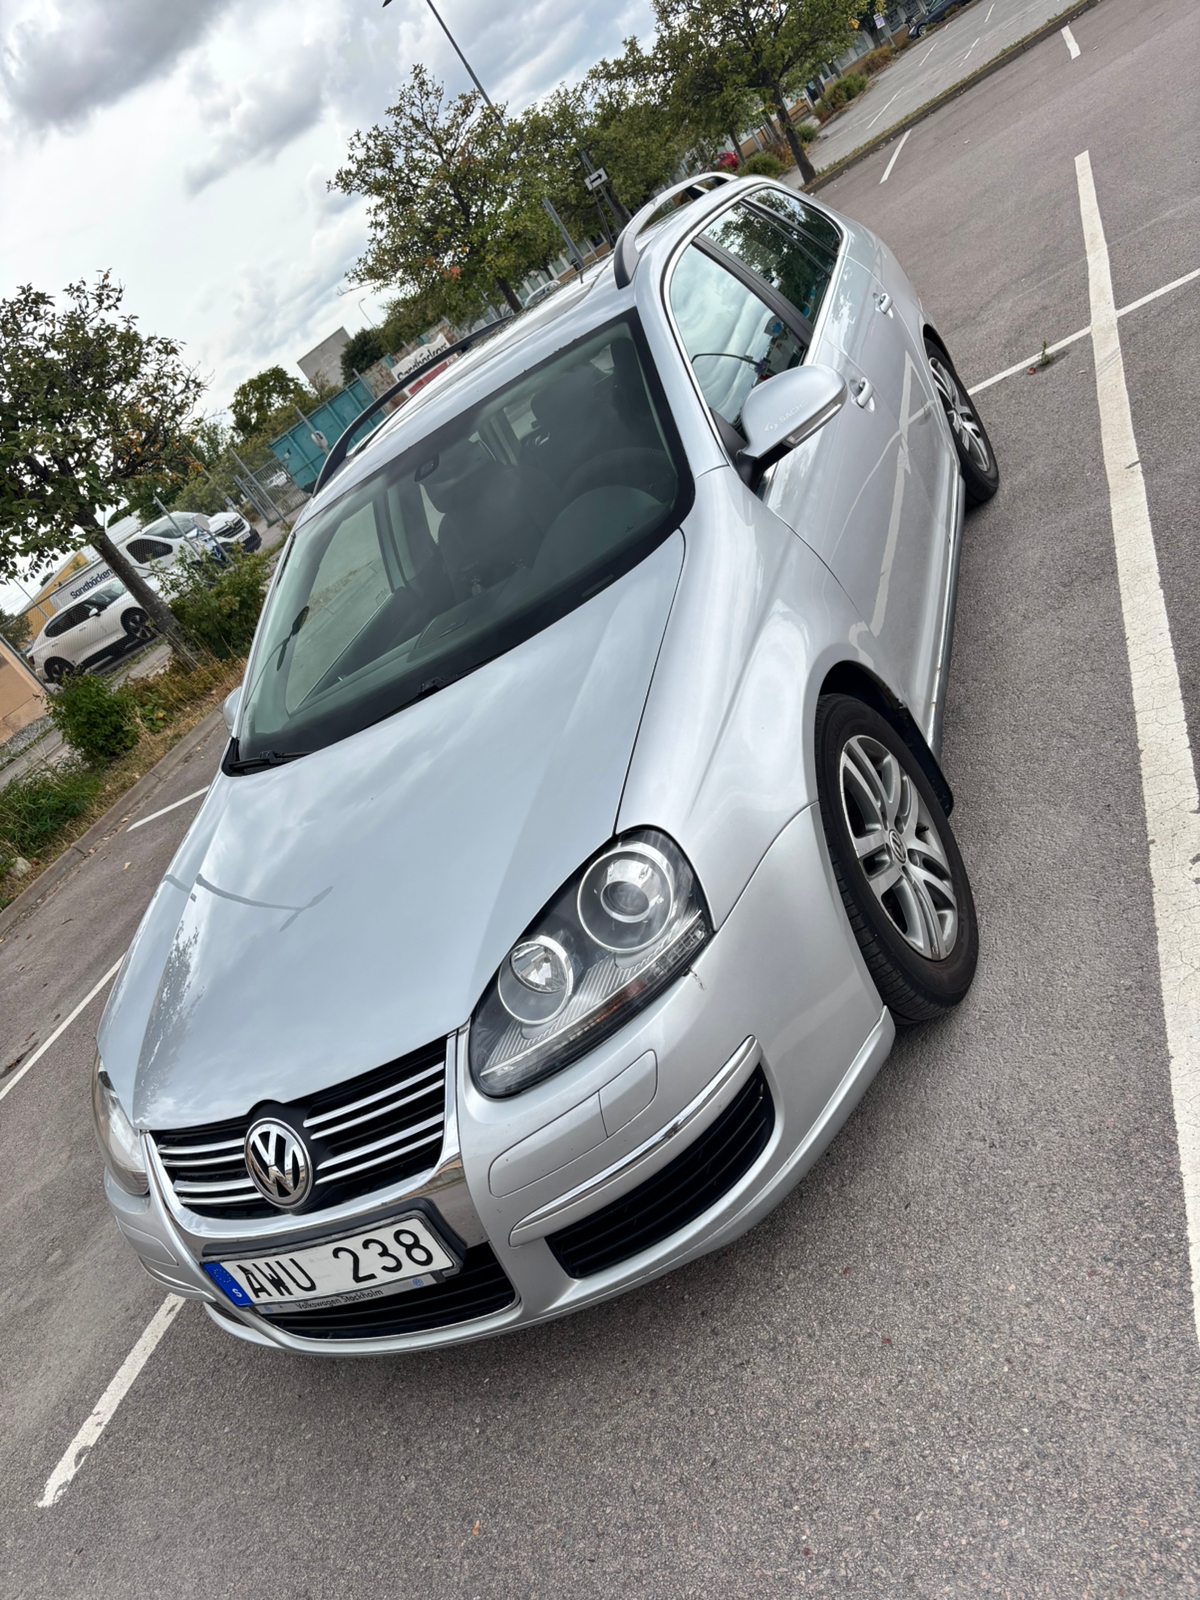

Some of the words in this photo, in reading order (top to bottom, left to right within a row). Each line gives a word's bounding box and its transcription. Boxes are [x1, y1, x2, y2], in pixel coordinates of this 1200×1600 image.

[779, 401, 809, 423] SACHS
[236, 1257, 317, 1299] AWU
[332, 1228, 434, 1284] 238
[231, 1287, 243, 1298] S
[295, 1298, 341, 1310] Volkswagen
[341, 1289, 384, 1303] Stockholm
